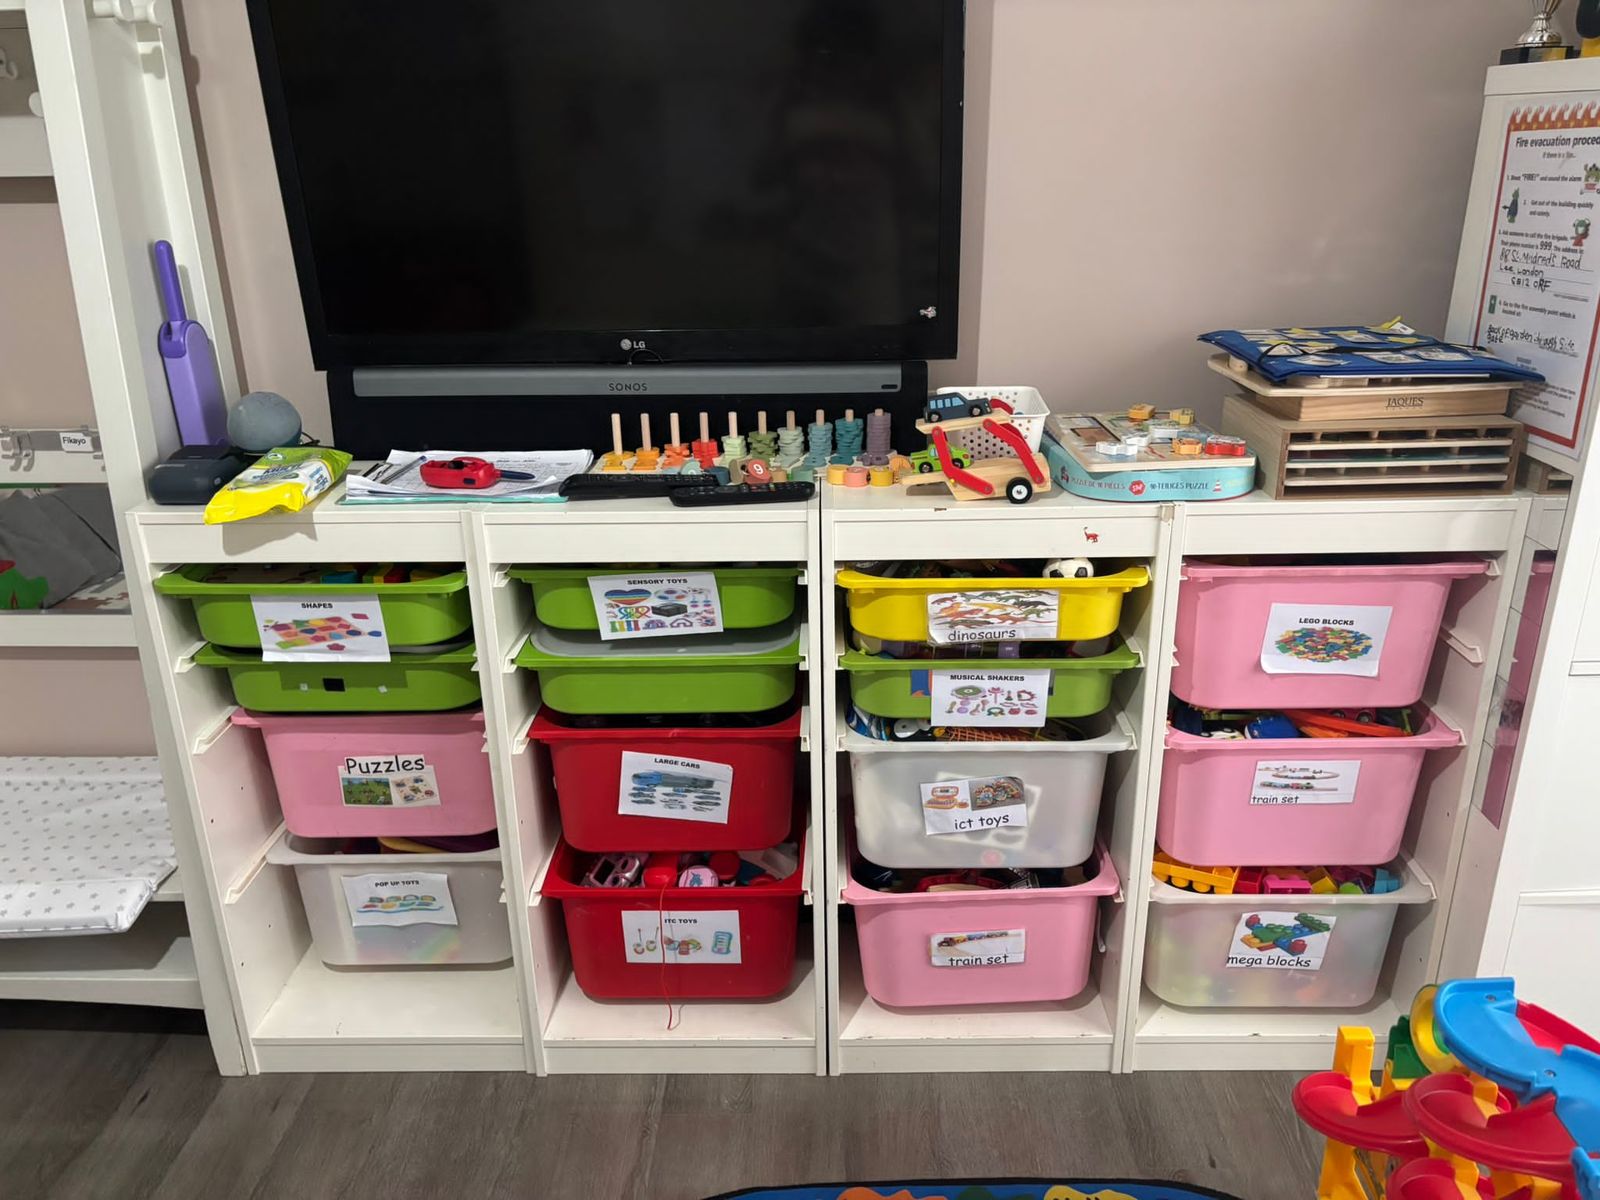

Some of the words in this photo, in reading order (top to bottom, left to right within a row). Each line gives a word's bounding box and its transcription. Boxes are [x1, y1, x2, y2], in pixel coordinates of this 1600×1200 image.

[1516, 137, 1528, 147] Fire
[1530, 136, 1570, 147] evacuation
[1561, 254, 1582, 270] Road
[633, 340, 646, 348] LG
[608, 383, 648, 391] SONOS
[1384, 396, 1424, 409] JAQUES
[62, 437, 86, 446] Fikayo
[1322, 618, 1355, 626] BLOCKS
[948, 629, 1016, 641] dinosaurs
[345, 754, 425, 774] Puzzles
[654, 757, 679, 766] LARGE
[680, 761, 701, 769] CARS
[1252, 795, 1278, 804] train
[1281, 795, 1299, 804] set
[954, 818, 974, 830] ict
[978, 814, 1010, 828] toys
[948, 956, 982, 967] train
[986, 954, 1009, 965] set
[1226, 955, 1262, 967] mega
[1267, 955, 1311, 967] blocks
